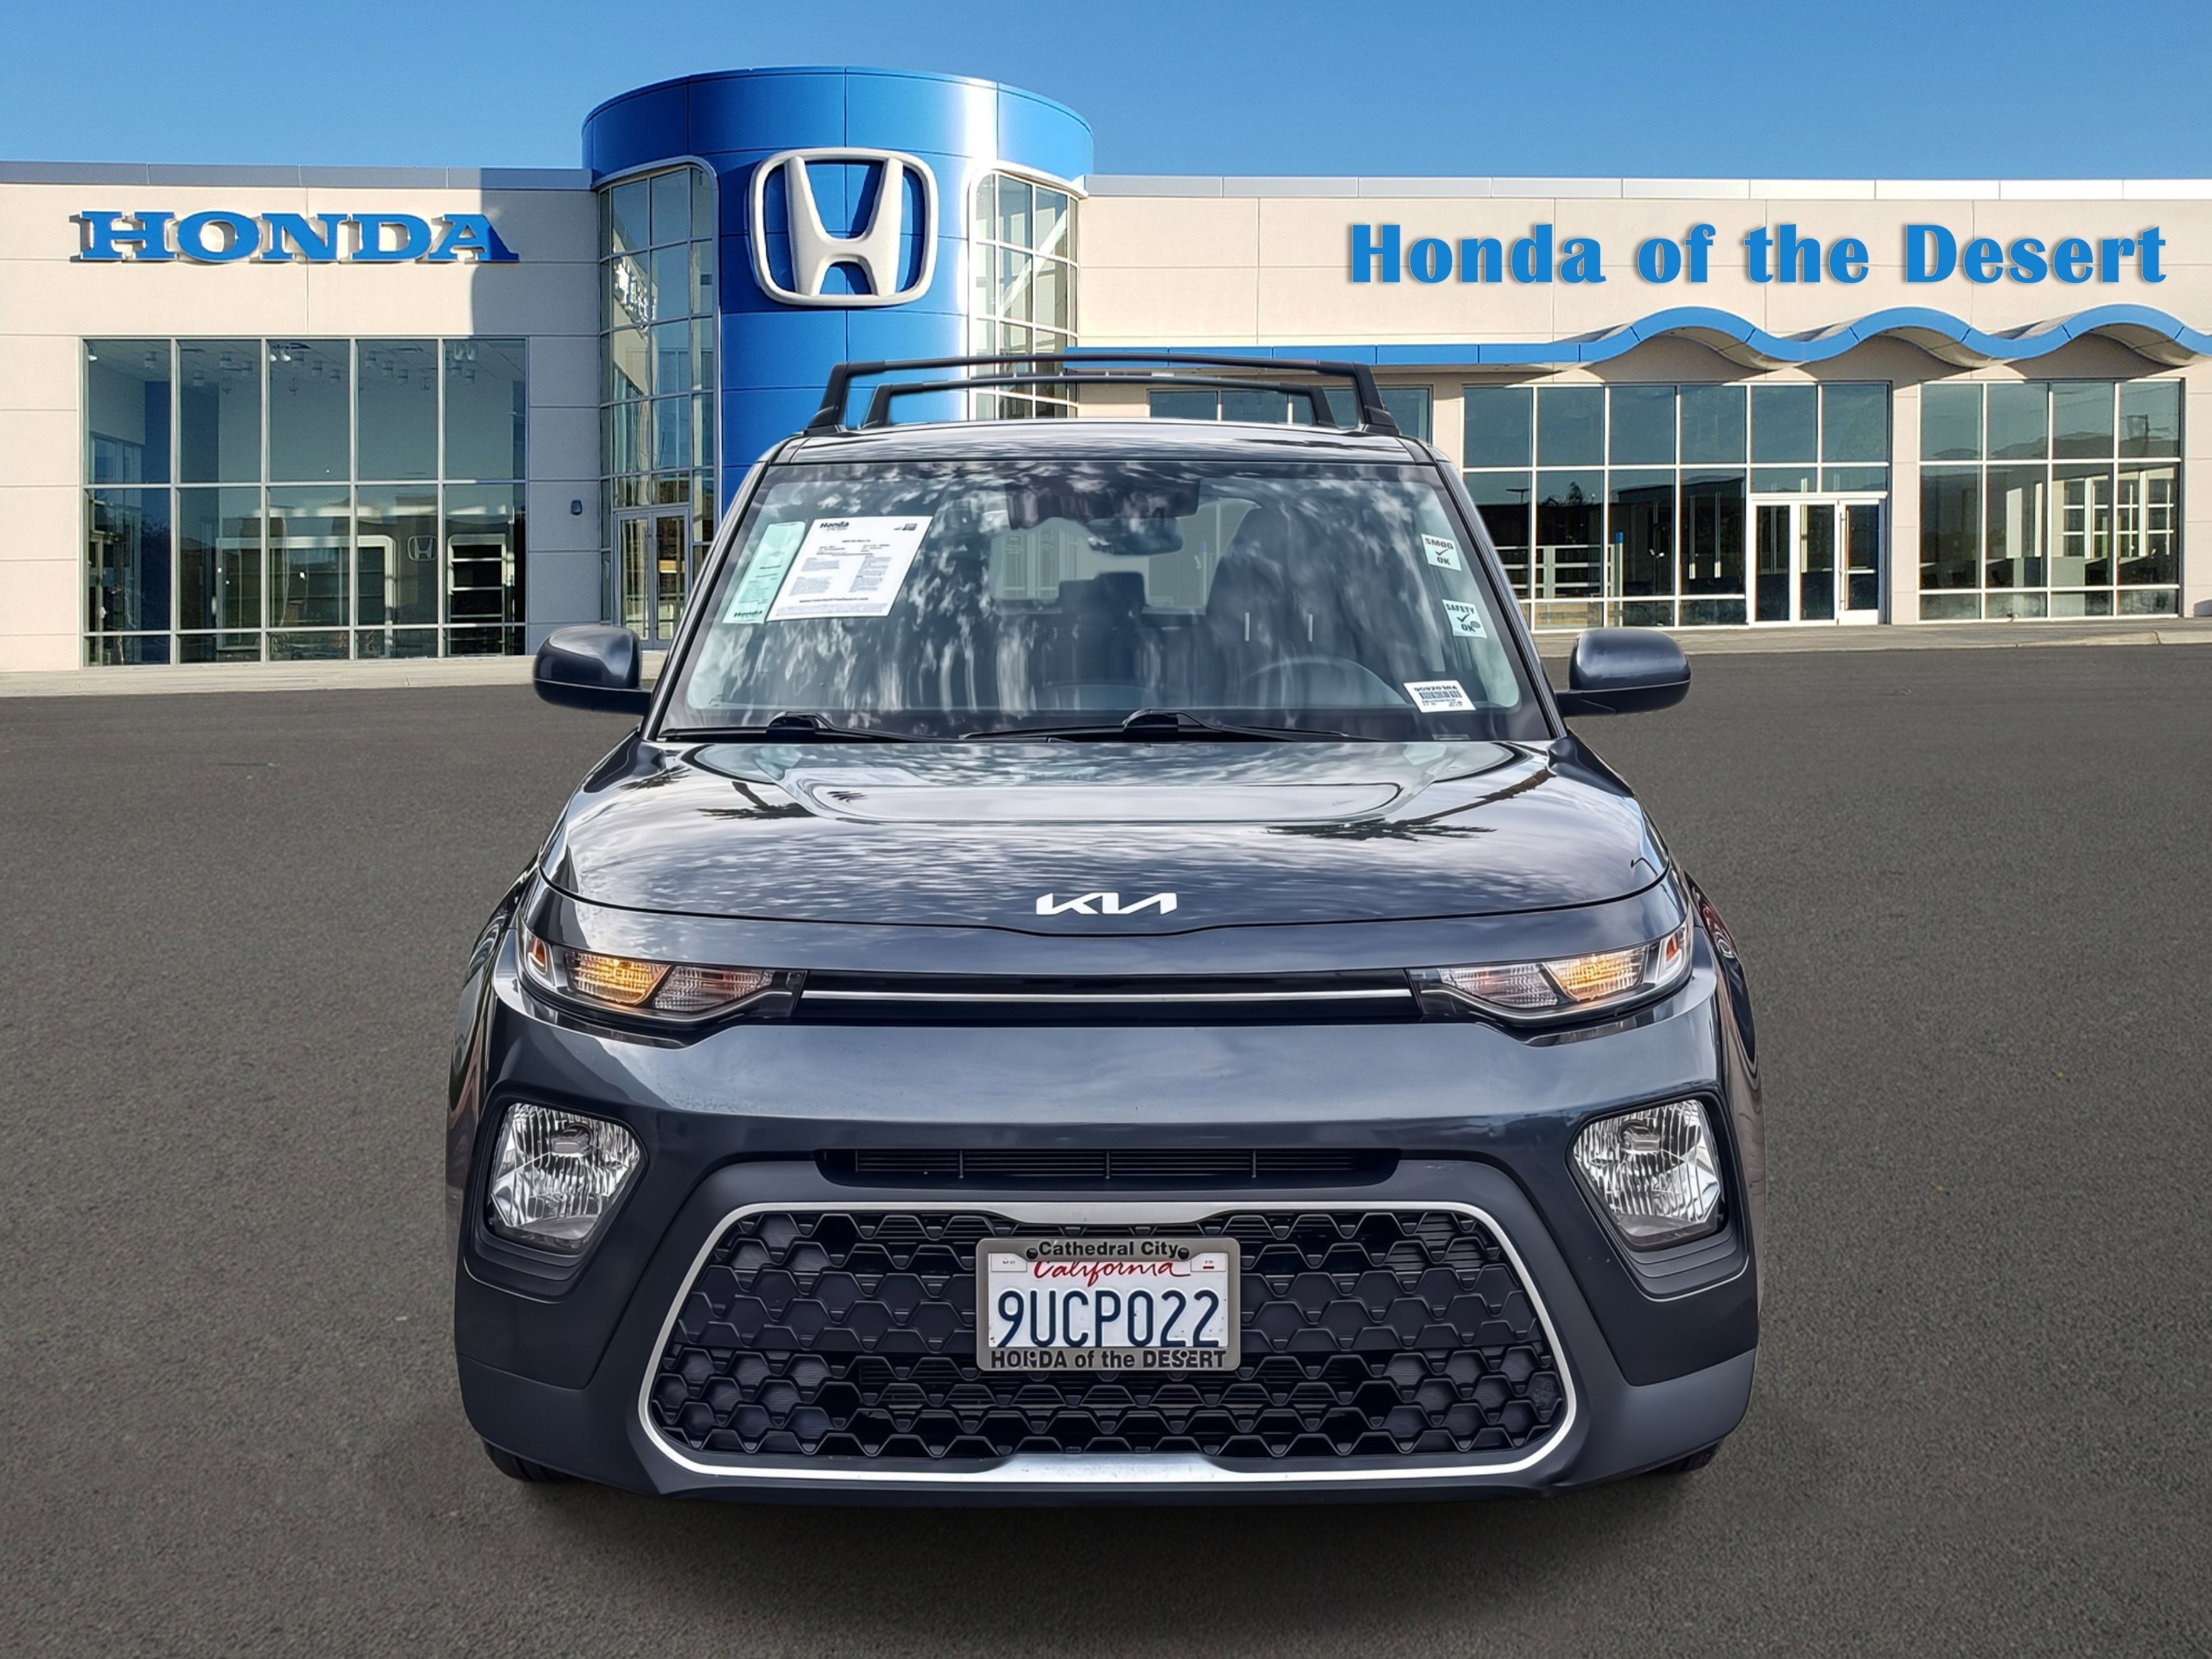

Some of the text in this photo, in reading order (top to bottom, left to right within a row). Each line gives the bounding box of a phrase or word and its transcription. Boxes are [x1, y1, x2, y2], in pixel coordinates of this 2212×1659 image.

[80, 210, 519, 263] HONDA
[1351, 223, 2167, 284] Honda of the Desert
[1437, 556, 1451, 565] OK
[1446, 603, 1474, 614] SAFETY
[1461, 623, 1475, 632] OK
[1038, 1240, 1179, 1258] Cathedral City
[1033, 1261, 1191, 1287] California
[997, 1289, 1220, 1348] 9UCP022
[991, 1349, 1227, 1368] HONDA of the DESERT
